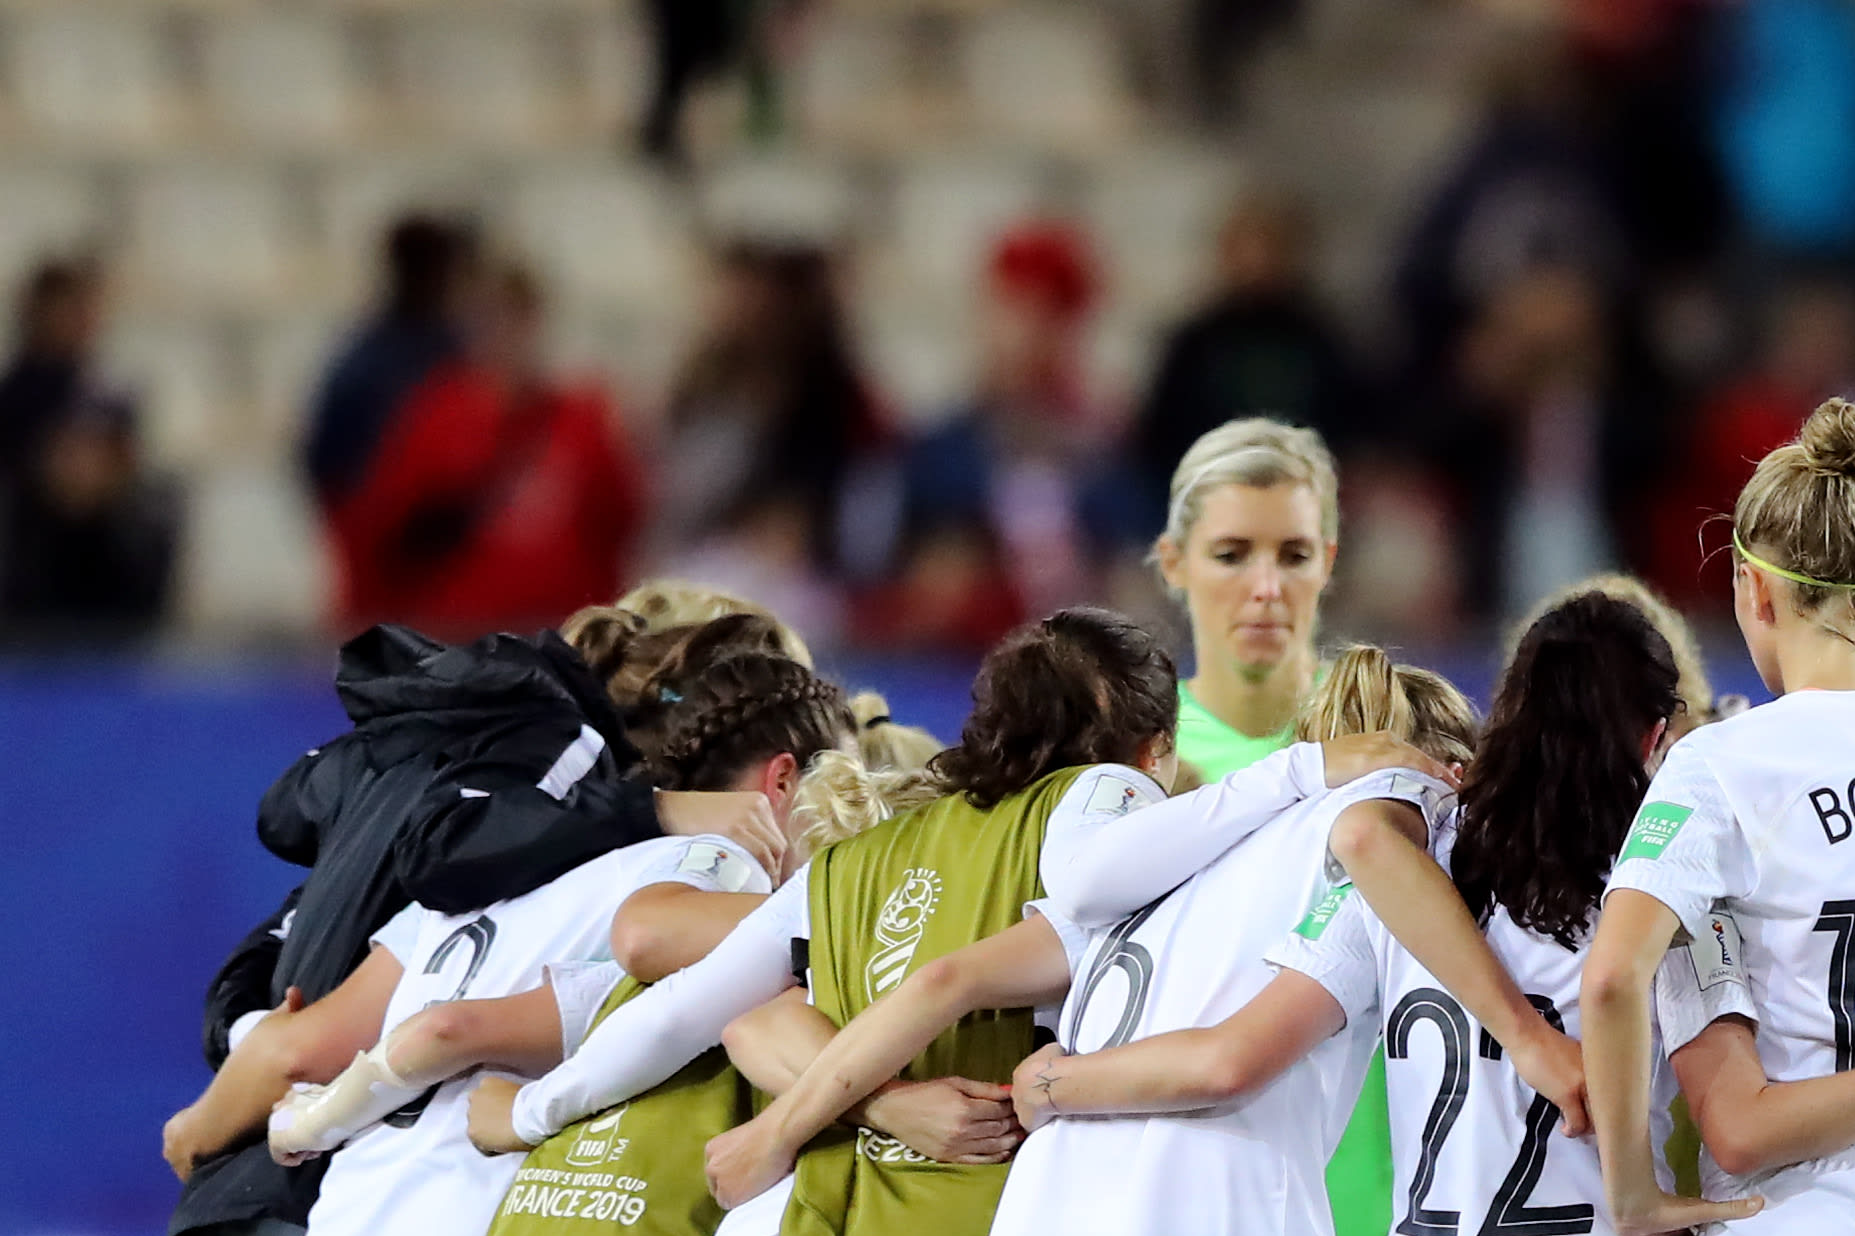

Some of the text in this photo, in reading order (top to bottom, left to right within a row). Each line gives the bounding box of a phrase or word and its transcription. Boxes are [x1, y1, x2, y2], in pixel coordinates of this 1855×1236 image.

[575, 1139, 607, 1157] FIFA
[571, 1172, 614, 1188] WORLD
[615, 1176, 648, 1193] CUP
[579, 1191, 646, 1226] 2019
